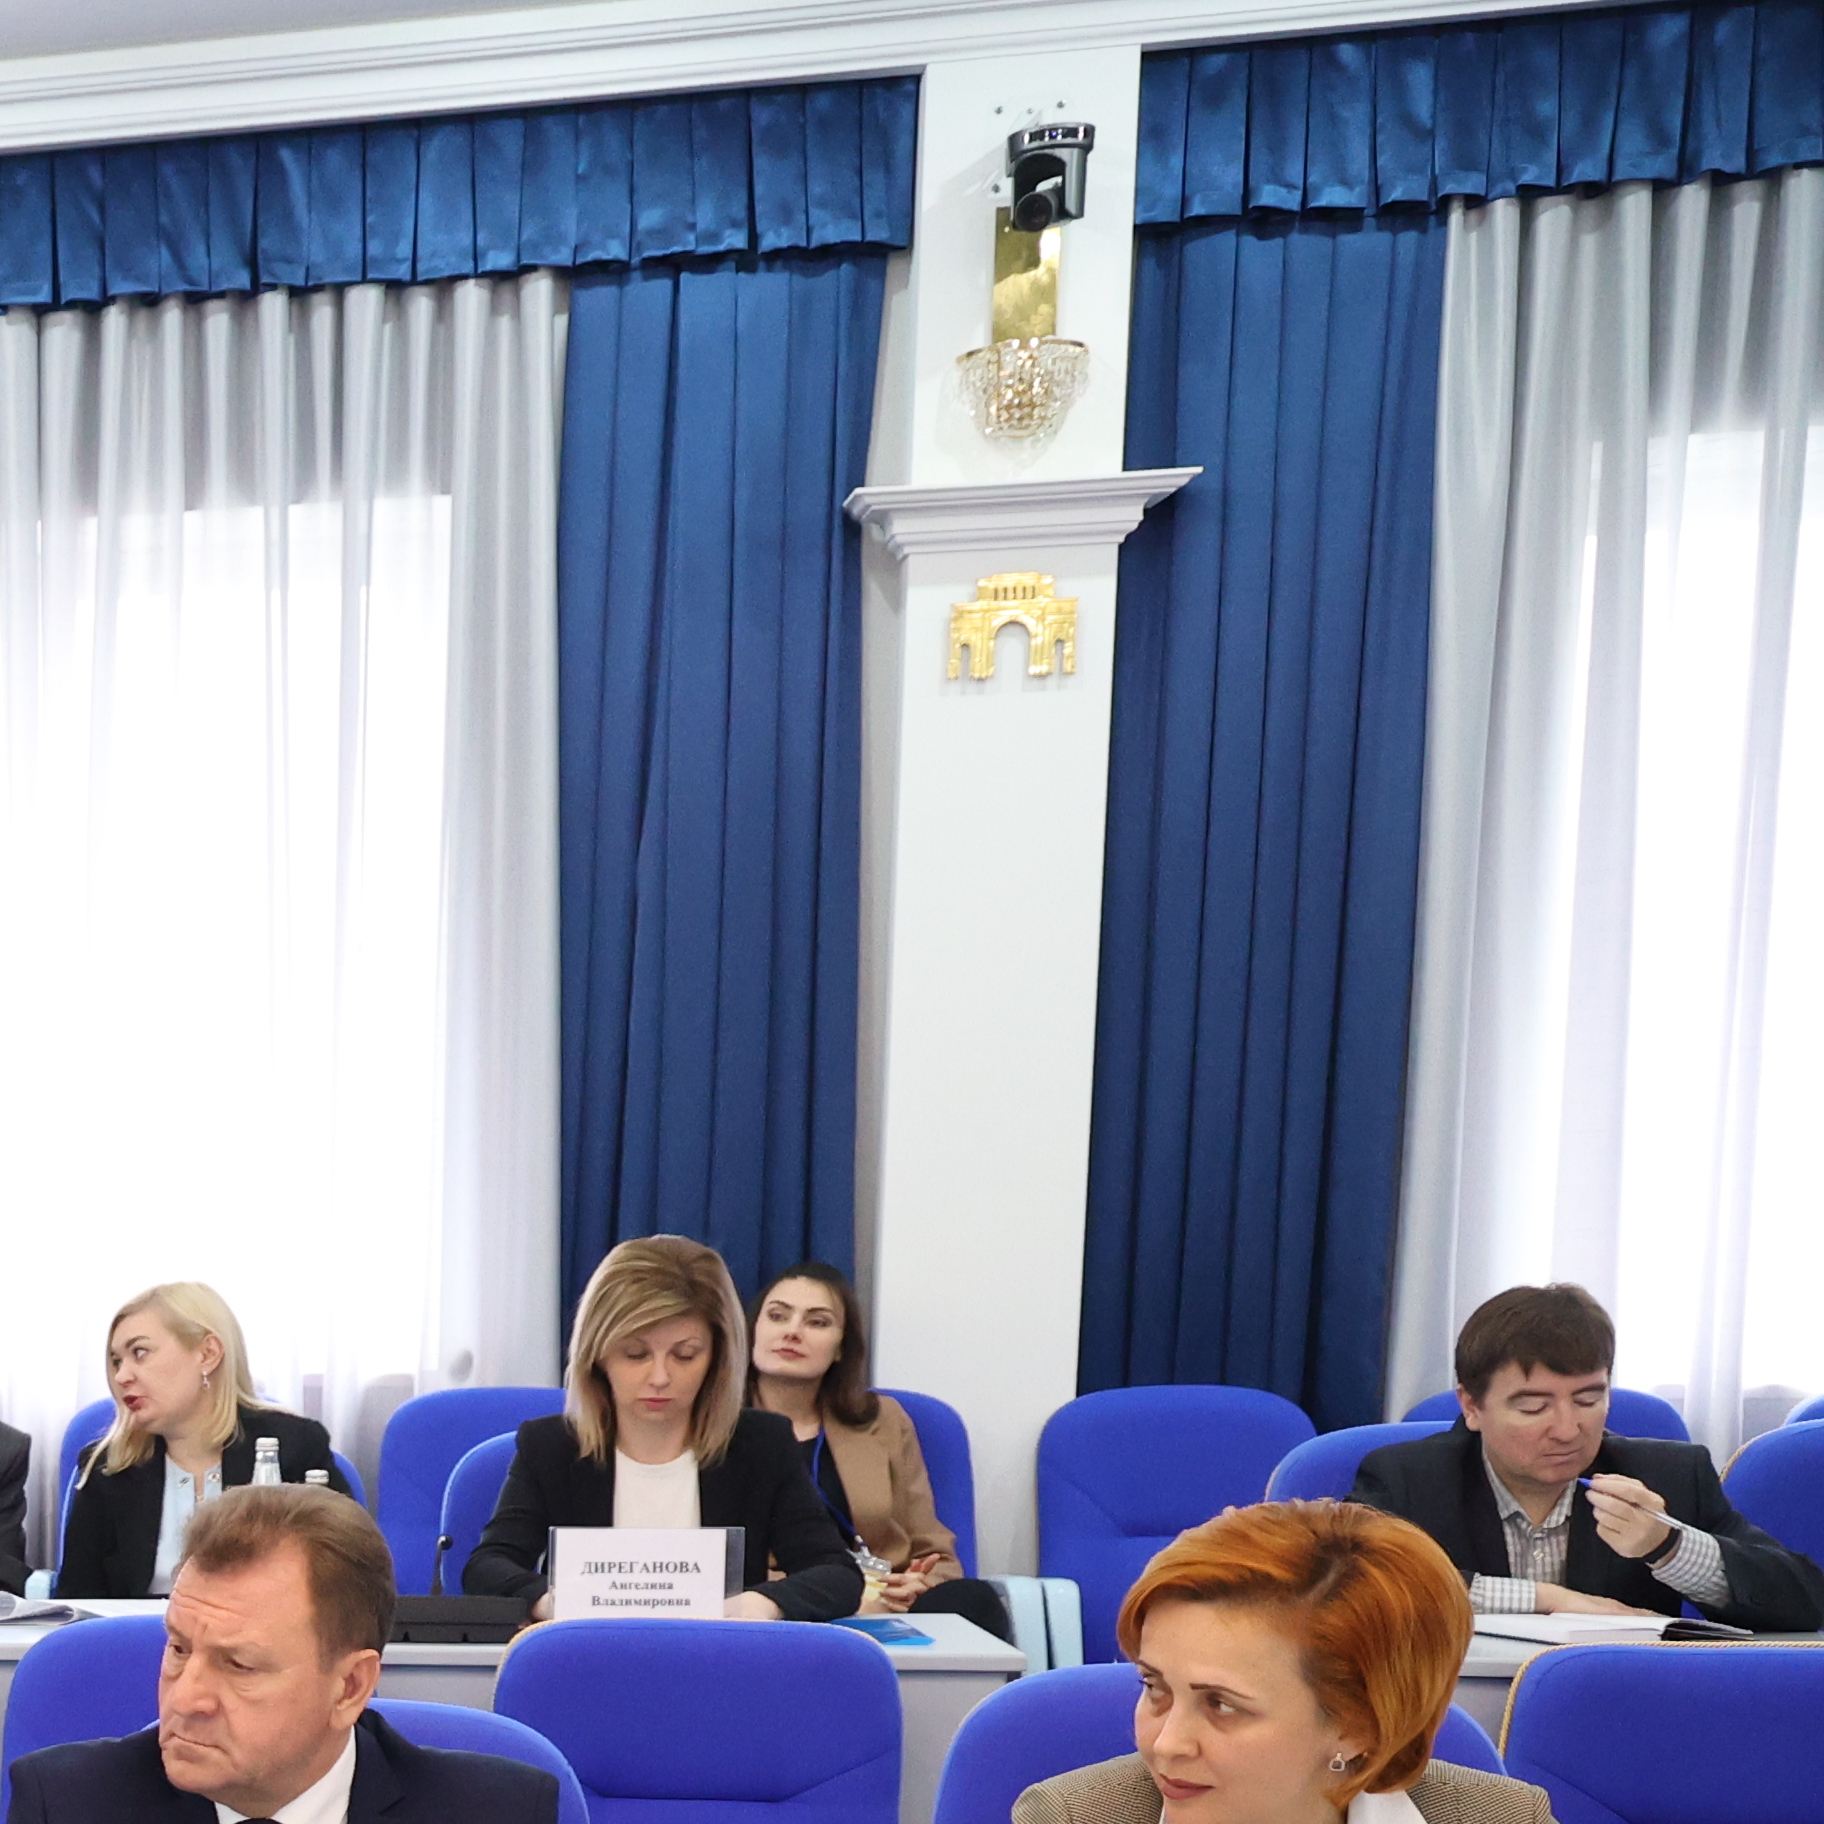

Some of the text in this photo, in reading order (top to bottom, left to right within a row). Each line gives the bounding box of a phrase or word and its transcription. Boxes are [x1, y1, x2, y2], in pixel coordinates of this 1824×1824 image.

[581, 1561, 701, 1575] ДИРЕГАНОВА
[609, 1581, 674, 1590] Ангелина
[591, 1596, 691, 1609] Владимировна
